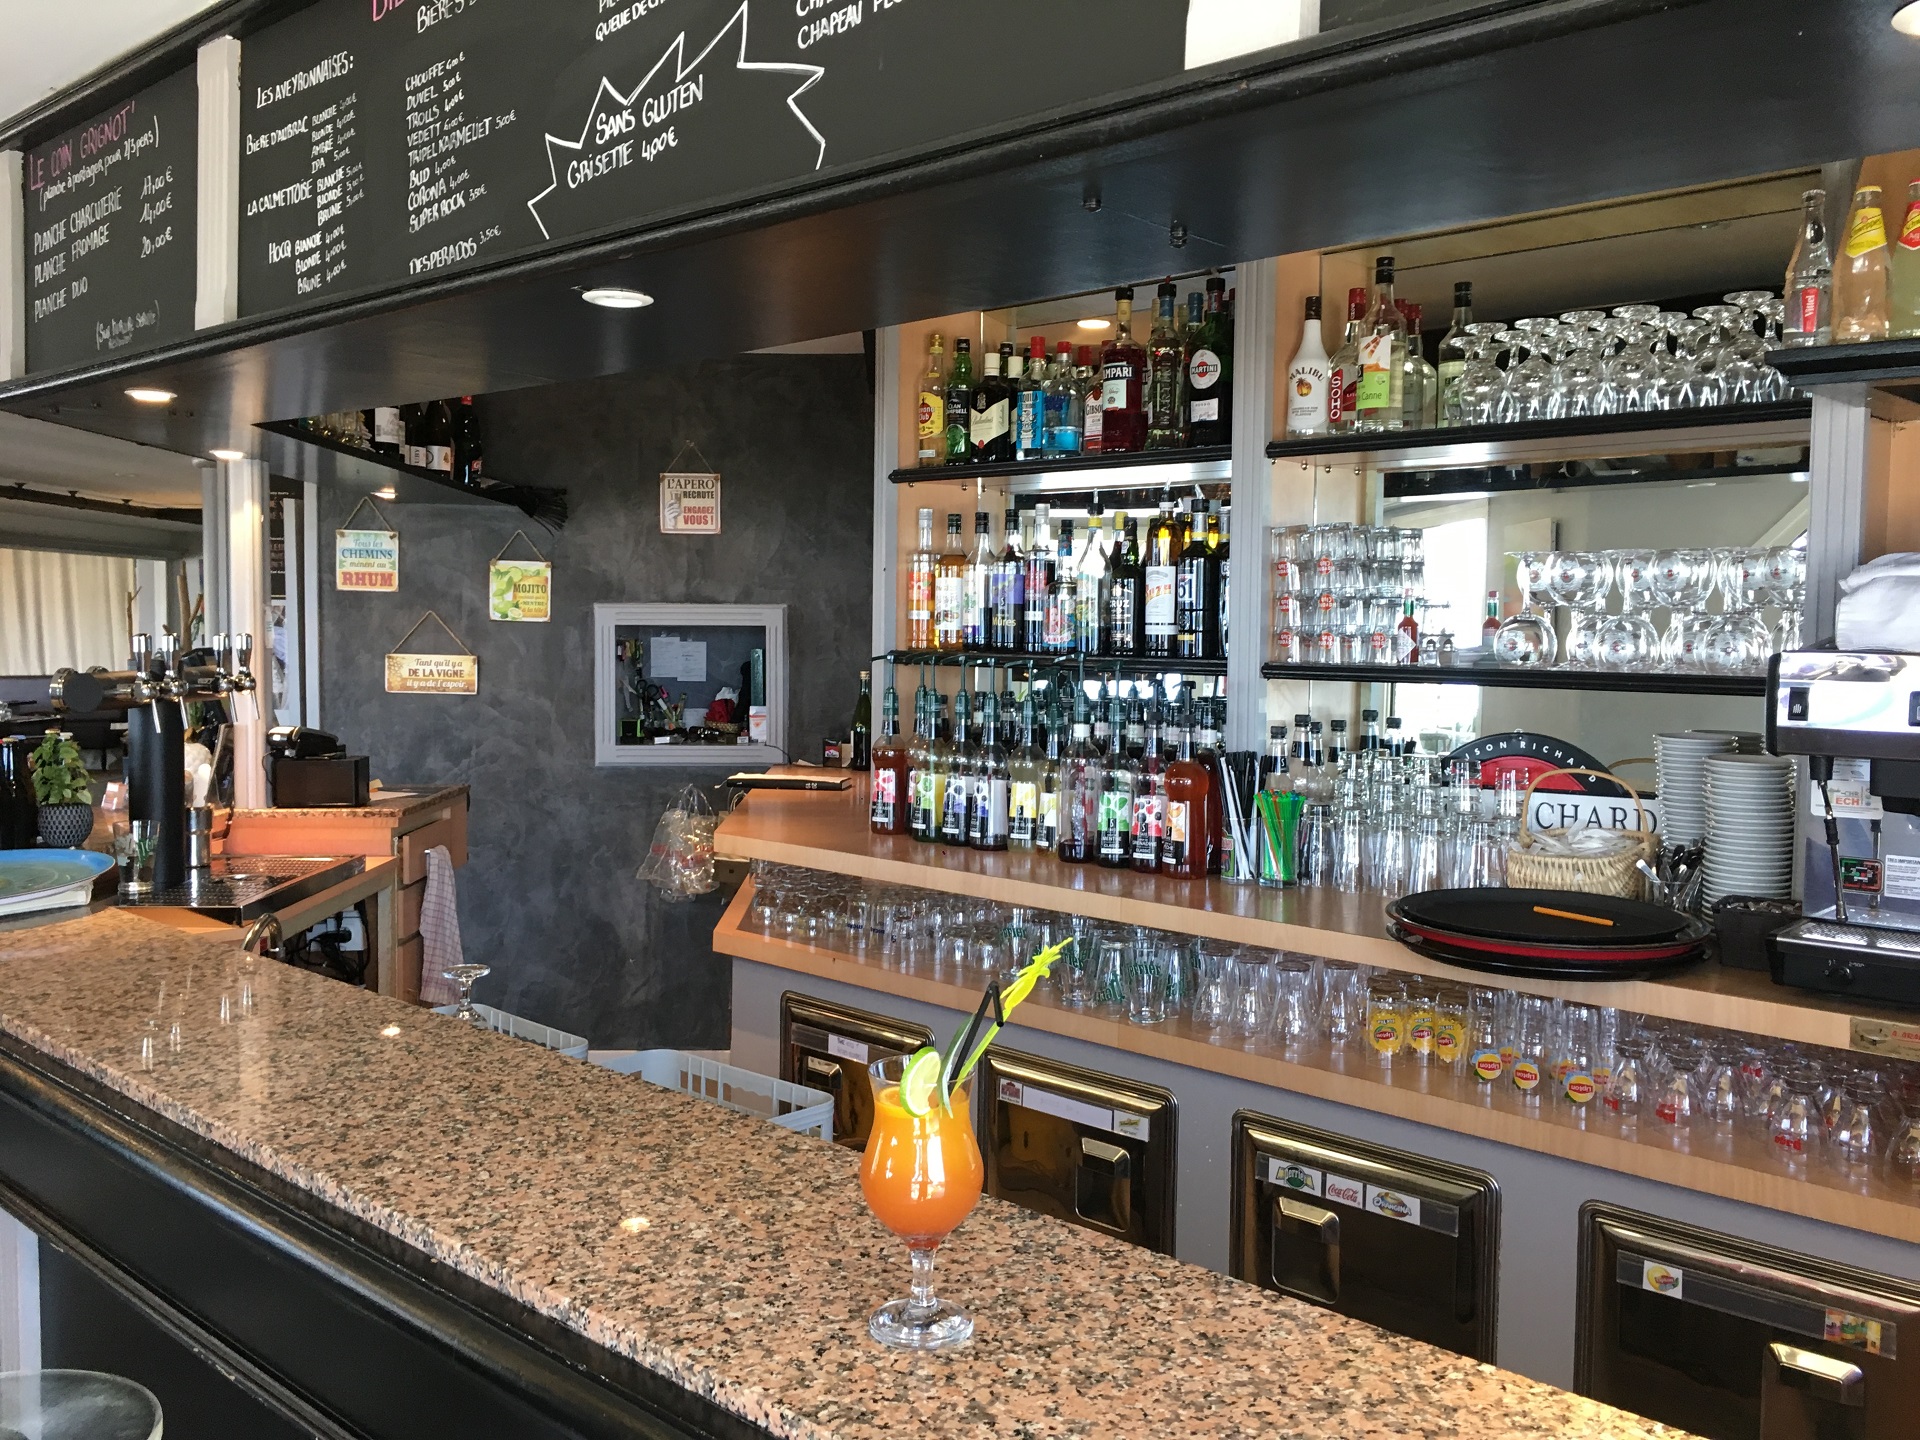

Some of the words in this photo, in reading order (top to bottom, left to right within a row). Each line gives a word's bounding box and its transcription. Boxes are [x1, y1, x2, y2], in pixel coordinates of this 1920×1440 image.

[595, 7, 631, 41] QUEUE
[797, 1, 862, 49] CHAPEAU
[405, 60, 445, 92] CHOUFFE
[256, 87, 273, 108] LES
[406, 85, 438, 111] DUVEL
[595, 108, 636, 145] SANS
[642, 74, 703, 128] GLUTEN
[405, 104, 439, 130] TROLLS
[407, 121, 441, 148] VEDETT
[30, 154, 45, 190] LE
[50, 139, 73, 177] COIN
[567, 139, 634, 189] GRISETTE
[247, 201, 258, 216] LA
[317, 165, 345, 193] BLANCHE
[409, 167, 430, 189] BUD
[317, 183, 343, 209] BLONDE
[407, 177, 447, 211] CORONA
[34, 217, 67, 255] PLANCHE
[70, 185, 123, 234] CHARCUTERIE
[318, 201, 343, 227] BRUNE
[409, 202, 440, 233] SUPER
[440, 190, 466, 217] BOCK
[34, 251, 67, 287] PLANCHE
[71, 223, 110, 262] FROMAGE
[269, 240, 291, 264] HOCQ
[294, 230, 322, 256] BLANCHE
[409, 237, 477, 275] DESPERADOS
[295, 250, 322, 275] BLONDE
[297, 273, 322, 295] BRUNE
[34, 287, 67, 323] PLANCHE
[72, 277, 88, 300] DUO
[1191, 363, 1217, 374] MARTINI
[1290, 366, 1325, 382] MALIBU
[1331, 376, 1341, 419] SOHO
[1362, 391, 1382, 401] Canne
[682, 490, 715, 499] RECRUTE
[683, 514, 709, 526] VOUS
[341, 548, 393, 560] CHEMINS
[341, 571, 394, 587] RHUM
[513, 583, 547, 594] MOJITO
[408, 669, 420, 677] DE
[422, 669, 435, 678] LA
[436, 670, 465, 679] VIGNE
[415, 658, 433, 667] Tant
[1480, 1062, 1500, 1070] Lipton
[1516, 1070, 1536, 1081] Lipton
[1570, 1084, 1592, 1093] Lipton
